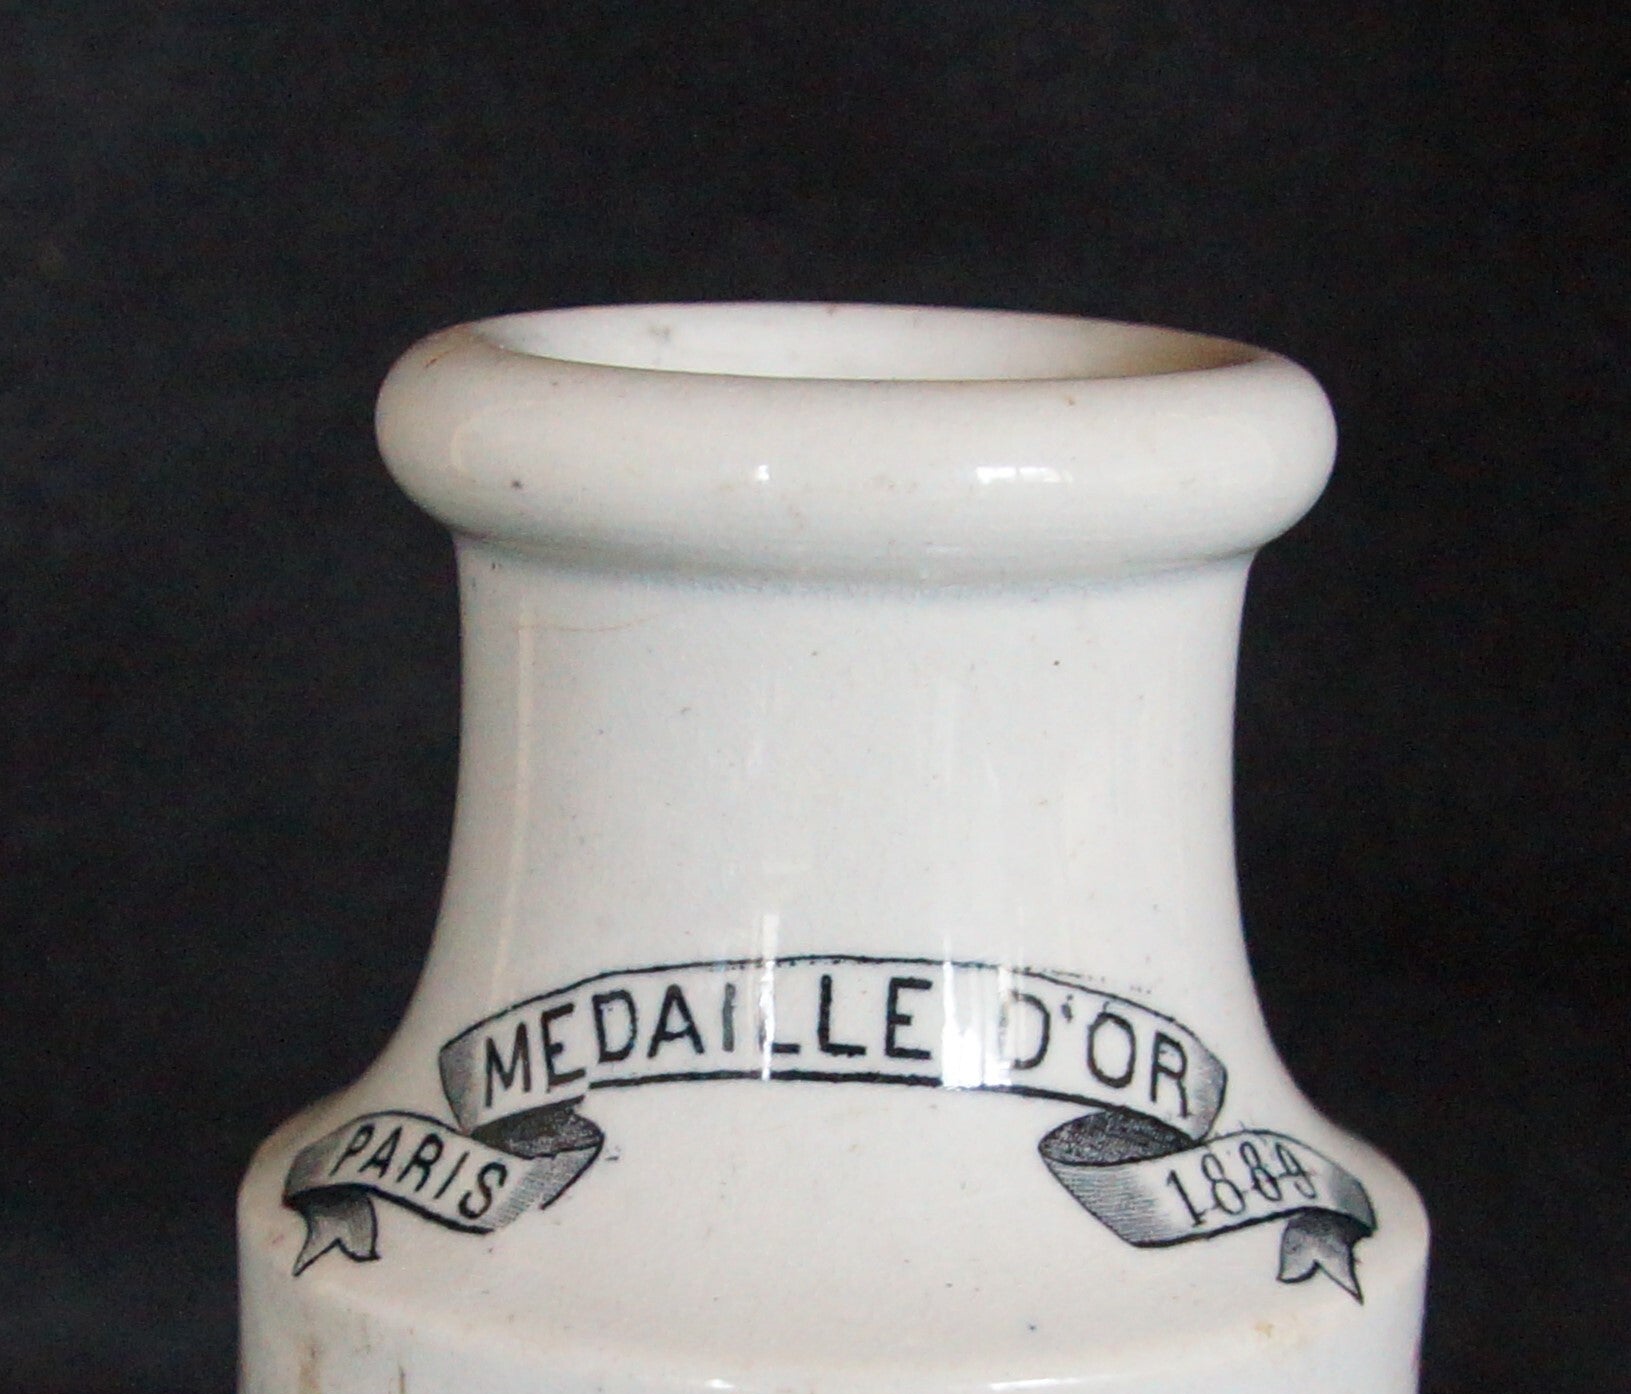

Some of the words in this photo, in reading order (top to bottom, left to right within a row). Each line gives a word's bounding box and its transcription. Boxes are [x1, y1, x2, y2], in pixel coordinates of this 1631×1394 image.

[484, 974, 933, 1108] MEDAILLE
[1000, 988, 1189, 1118] D'OR
[330, 1123, 509, 1220] PARIS
[1166, 1140, 1318, 1227] 1889
